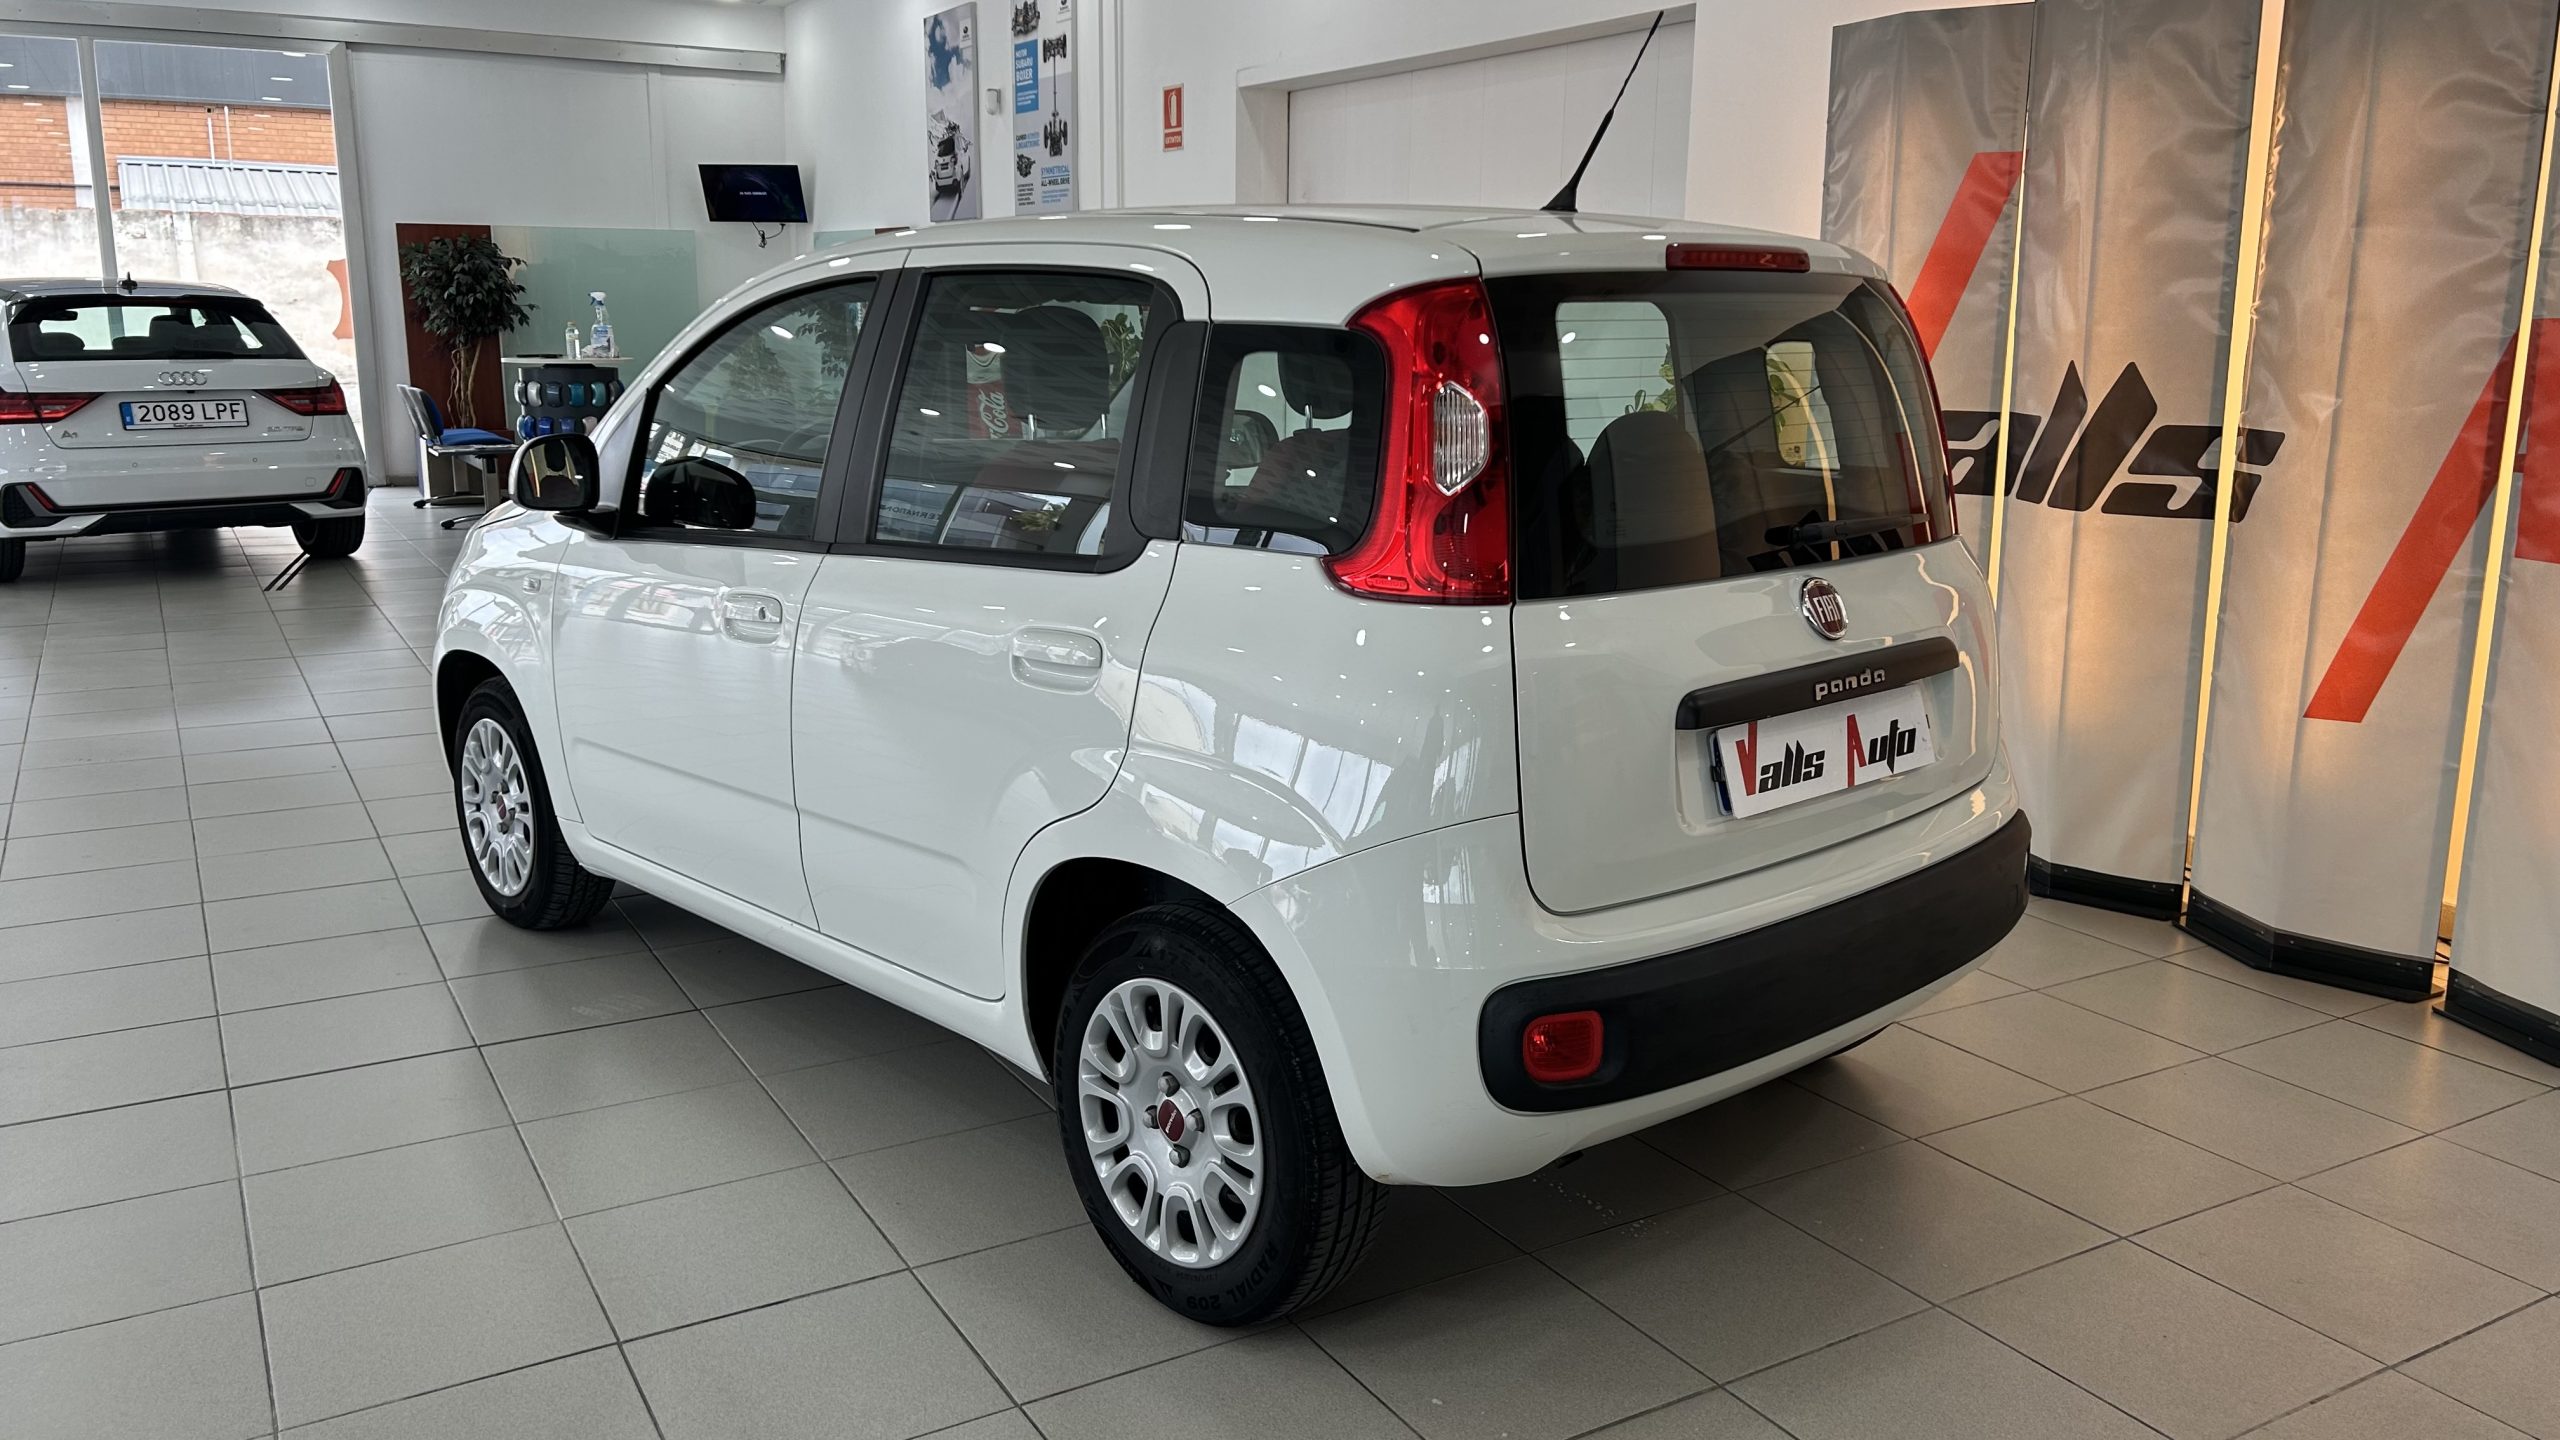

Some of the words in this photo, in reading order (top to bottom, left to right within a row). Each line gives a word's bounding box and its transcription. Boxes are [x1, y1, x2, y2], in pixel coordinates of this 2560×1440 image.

[1016, 57, 1033, 69] SUBARU
[1016, 68, 1033, 82] BOXER
[138, 404, 195, 423] 2089
[201, 402, 240, 421] LPF
[1813, 594, 1840, 624] FIAT
[1815, 667, 1886, 701] panda
[1735, 721, 1826, 796] Valls
[1846, 714, 1917, 788] Auto
[1185, 1294, 1221, 1311] 209
